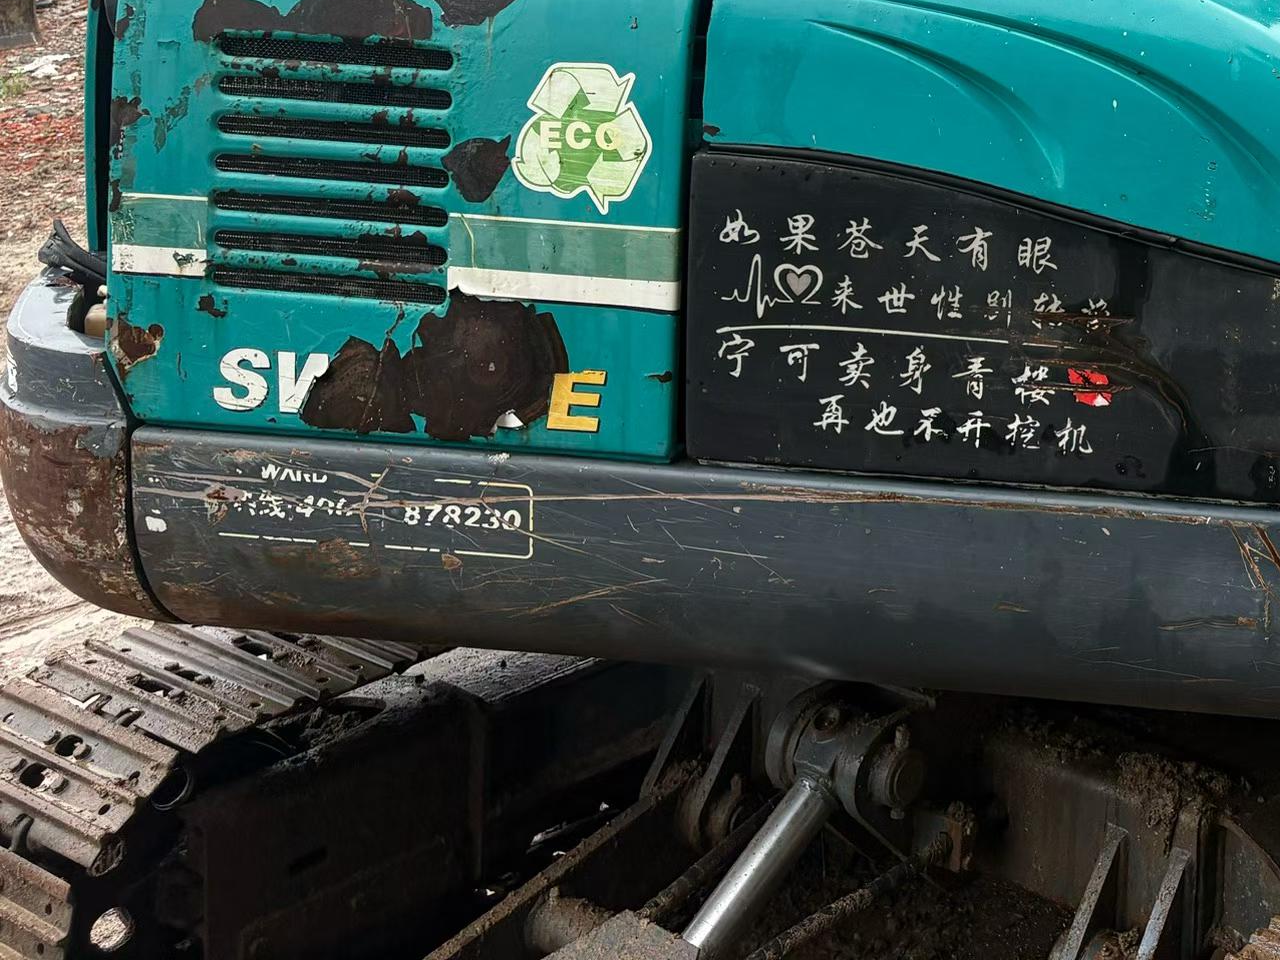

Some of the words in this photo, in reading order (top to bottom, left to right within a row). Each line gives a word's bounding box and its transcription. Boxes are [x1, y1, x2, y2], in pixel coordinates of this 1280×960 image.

[539, 121, 622, 151] ECO
[719, 209, 1058, 273] 如果苍天有眼
[718, 334, 1056, 407] 宁可卖身青楼
[814, 394, 1095, 456] 再也不开挖机
